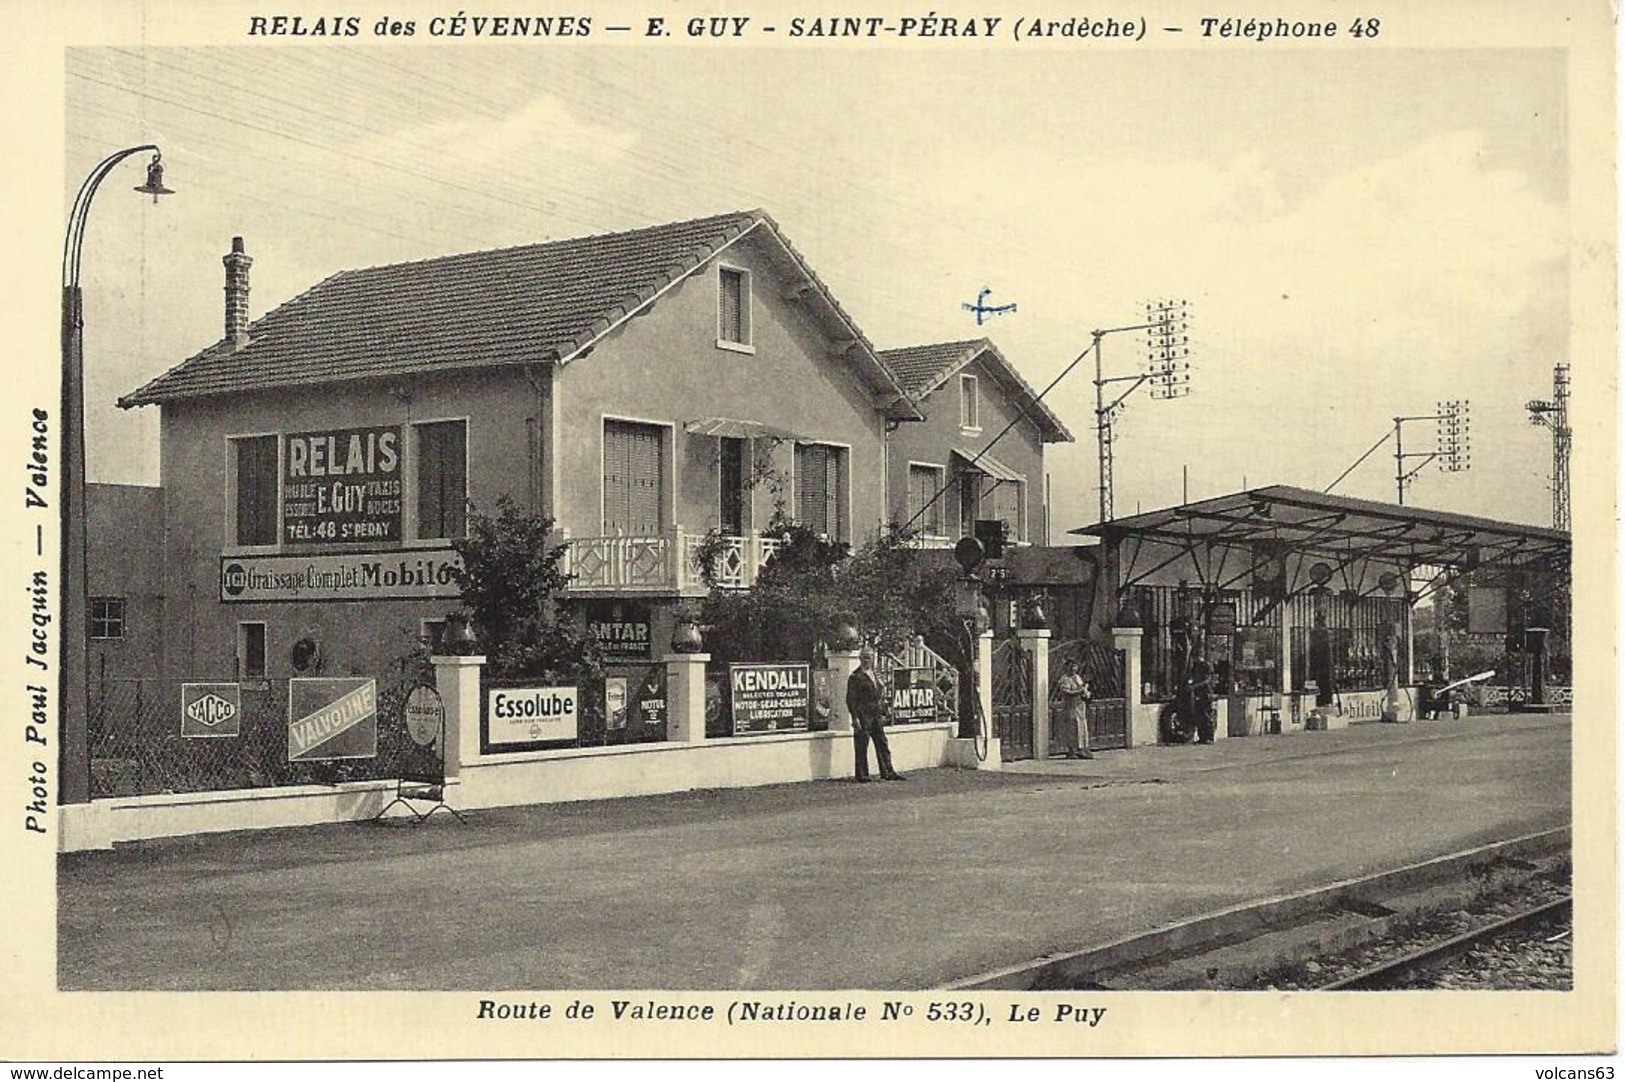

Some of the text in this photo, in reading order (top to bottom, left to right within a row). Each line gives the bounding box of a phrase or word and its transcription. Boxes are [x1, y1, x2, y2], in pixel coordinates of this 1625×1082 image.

[290, 432, 397, 477] RELAIS
[366, 481, 400, 497] TAXIS
[355, 519, 390, 537] PÉRAY
[248, 567, 304, 596] Graissage
[307, 564, 358, 592] Complet
[734, 670, 807, 691] KENDALL
[495, 693, 573, 718] Essolube
[894, 688, 934, 708] ANTAR
[191, 696, 232, 724] YACCO
[292, 687, 373, 748] VALVOLINE
[750, 708, 793, 720] LUBRICATION
